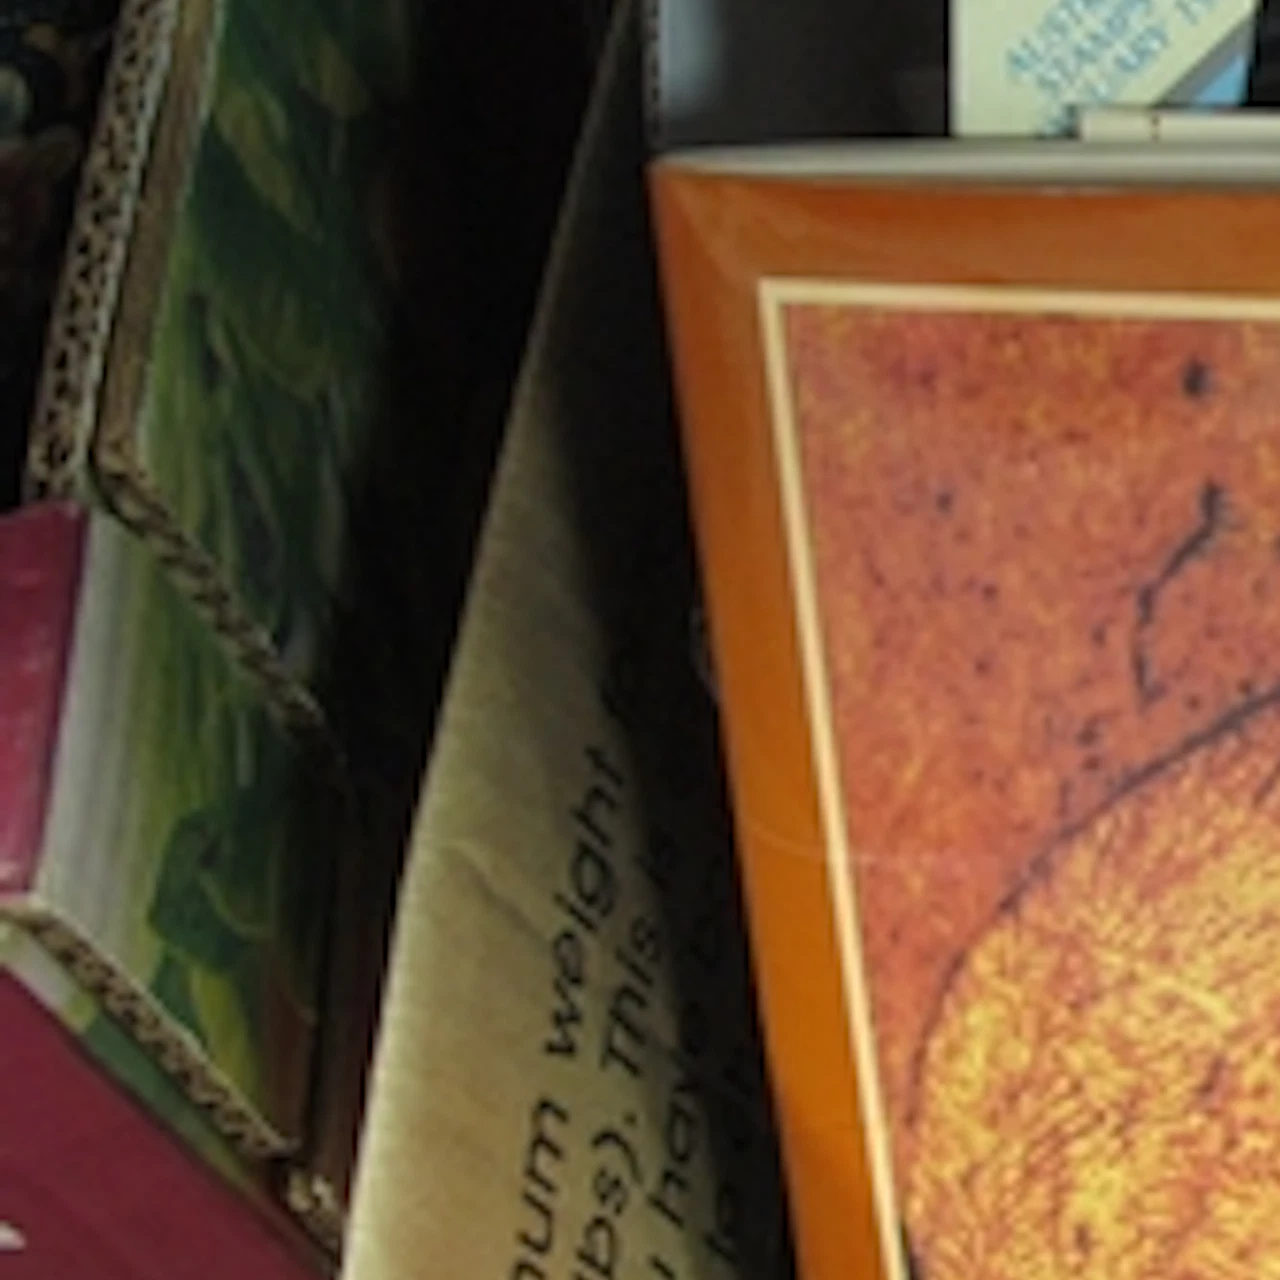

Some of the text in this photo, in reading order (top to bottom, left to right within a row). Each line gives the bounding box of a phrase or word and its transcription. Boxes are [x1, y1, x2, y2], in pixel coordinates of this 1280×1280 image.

[540, 746, 624, 1062] weight
[600, 916, 660, 1078] This
[647, 1000, 708, 1230] have
